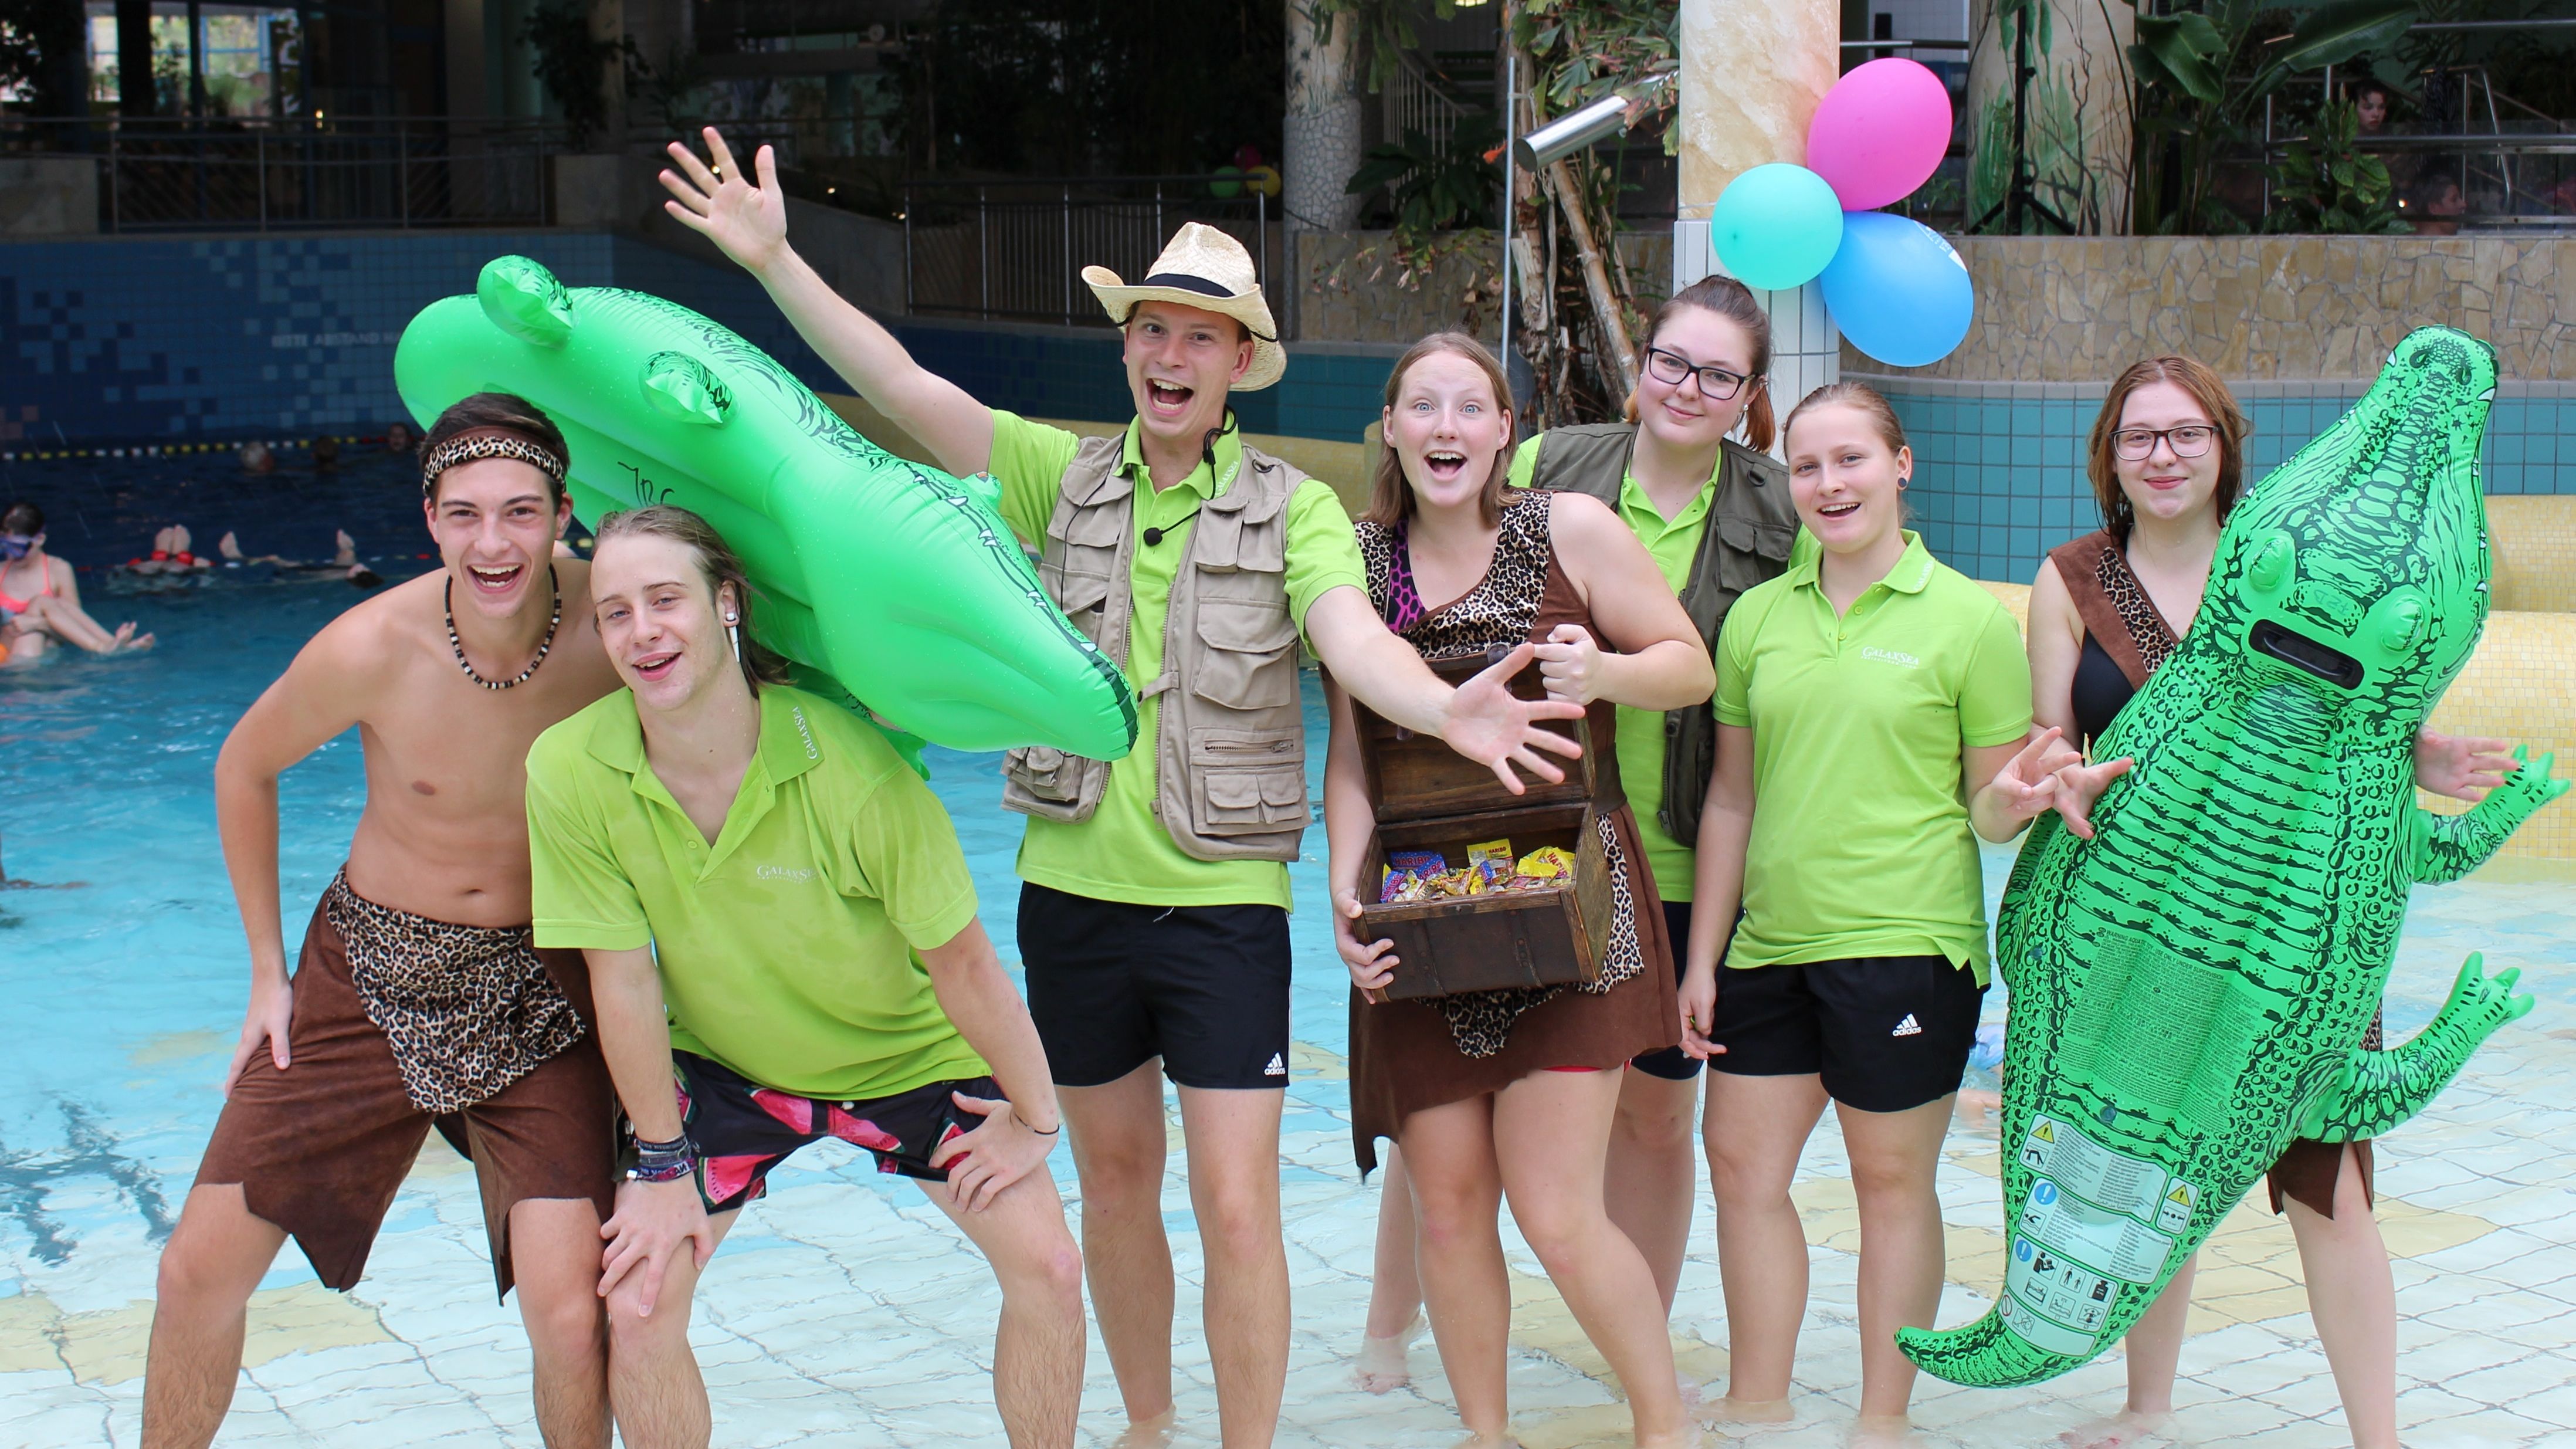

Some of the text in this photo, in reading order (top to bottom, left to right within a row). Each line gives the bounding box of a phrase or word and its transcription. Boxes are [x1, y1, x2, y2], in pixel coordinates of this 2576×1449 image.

[2106, 930, 2128, 941] WARNING
[2163, 953, 2175, 963] ONLY
[2176, 960, 2193, 970] UNDER
[2193, 966, 2224, 980] SUPERVISION
[1892, 1027, 1921, 1037] adidas
[1264, 1067, 1286, 1075] adidas
